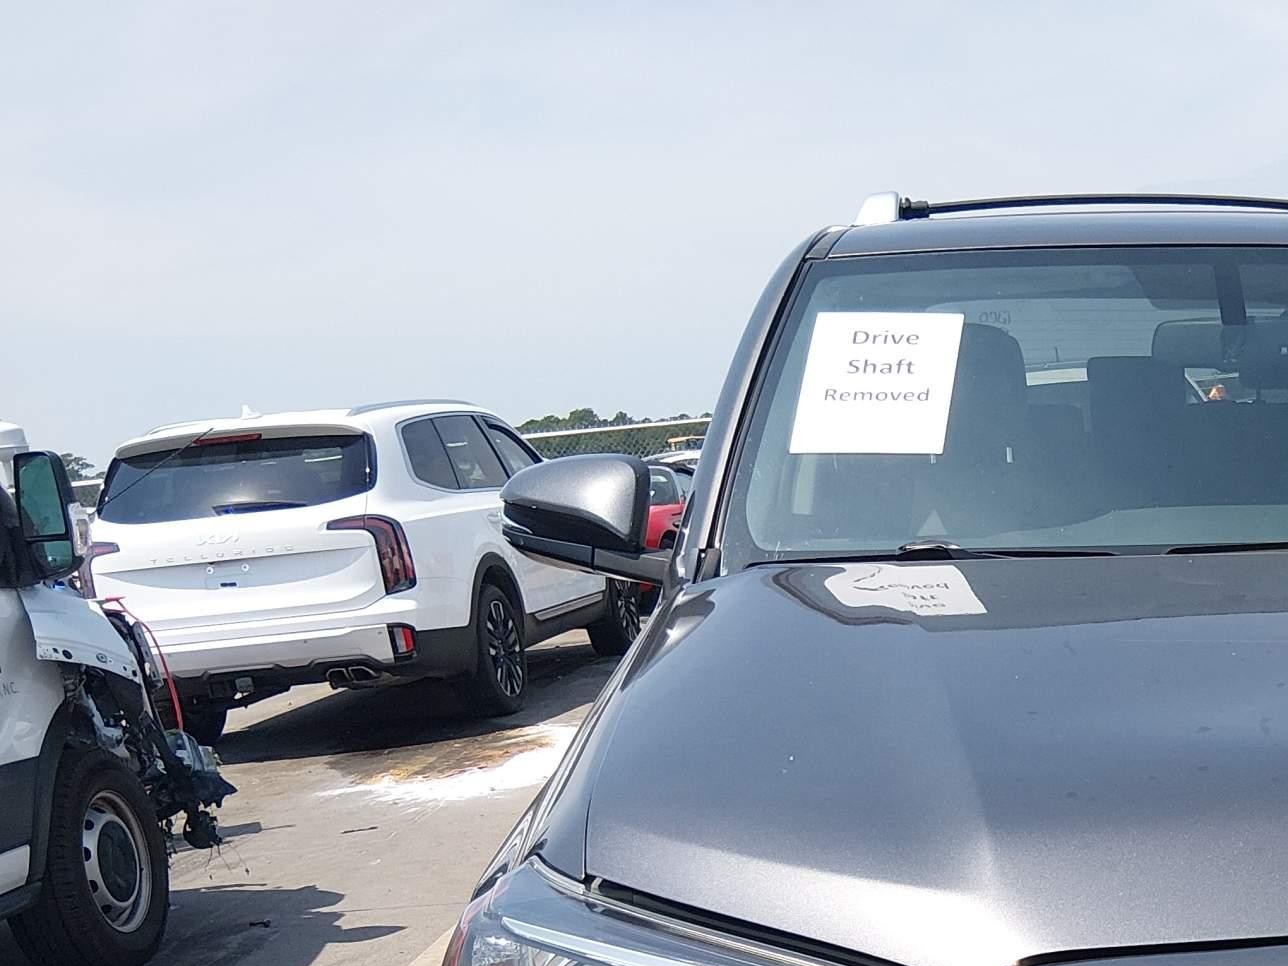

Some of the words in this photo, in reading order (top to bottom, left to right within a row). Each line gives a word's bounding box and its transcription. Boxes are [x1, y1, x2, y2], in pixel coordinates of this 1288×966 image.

[852, 329, 920, 346] Drive
[847, 358, 915, 375] Shaft
[824, 387, 931, 402] Removed
[150, 544, 295, 565] TELLURIDE
